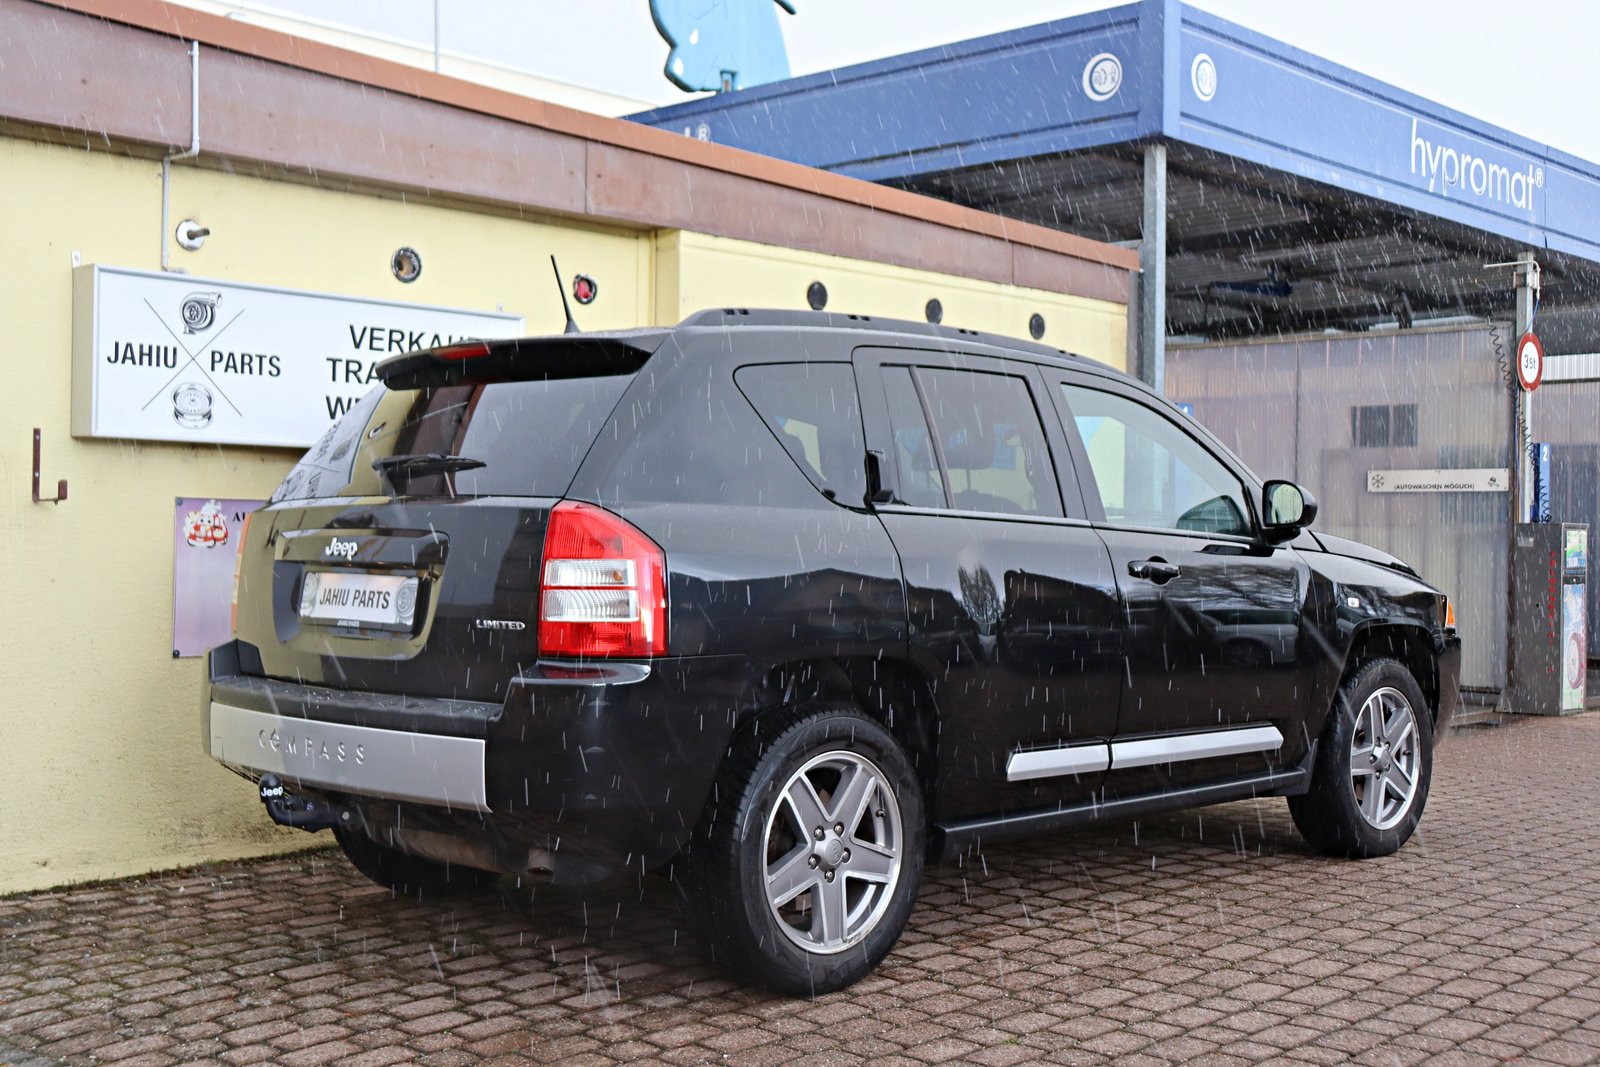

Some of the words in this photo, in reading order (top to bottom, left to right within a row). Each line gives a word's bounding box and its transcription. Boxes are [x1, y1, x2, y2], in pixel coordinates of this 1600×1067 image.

[107, 341, 178, 369] JAHIU
[210, 350, 281, 378] PARTS
[1542, 445, 1548, 462] 2
[325, 537, 358, 561] Jeep
[319, 587, 350, 607] JAHIU
[351, 589, 391, 609] PARTS
[475, 619, 526, 631] LIMITED
[258, 728, 365, 765] COMPASS
[260, 786, 284, 797] Jeep
